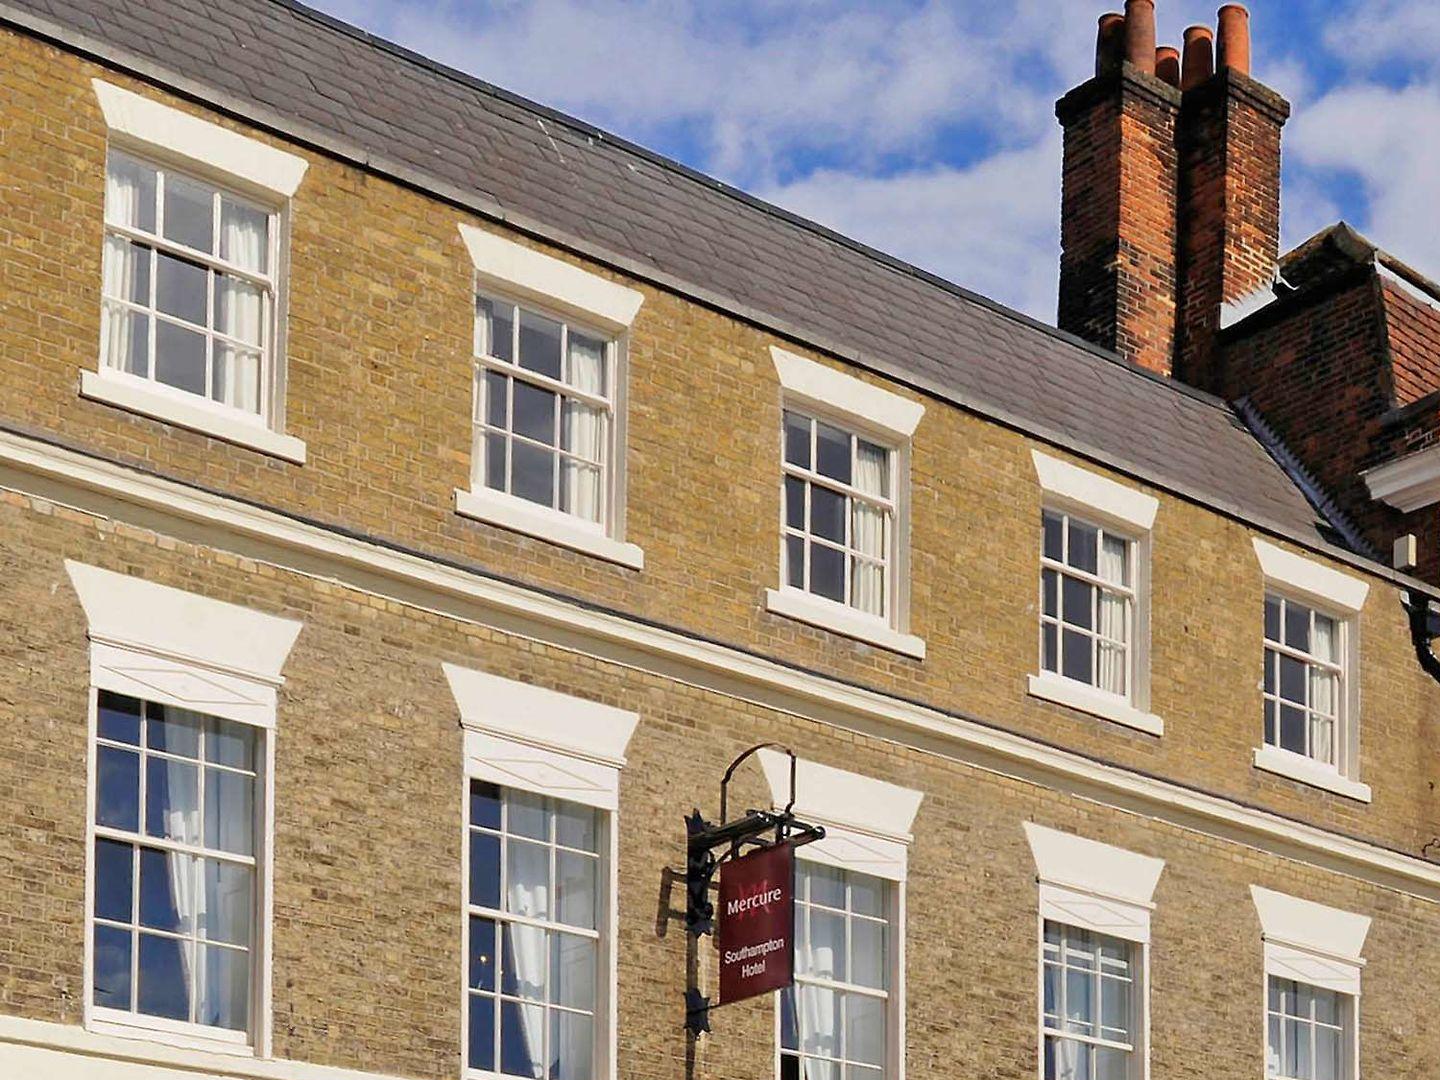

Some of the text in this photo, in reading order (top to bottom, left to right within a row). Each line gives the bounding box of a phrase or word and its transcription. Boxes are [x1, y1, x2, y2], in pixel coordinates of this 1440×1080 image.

[727, 888, 782, 915] Mercure
[724, 938, 784, 964] Southampton
[741, 961, 766, 978] Hotel
